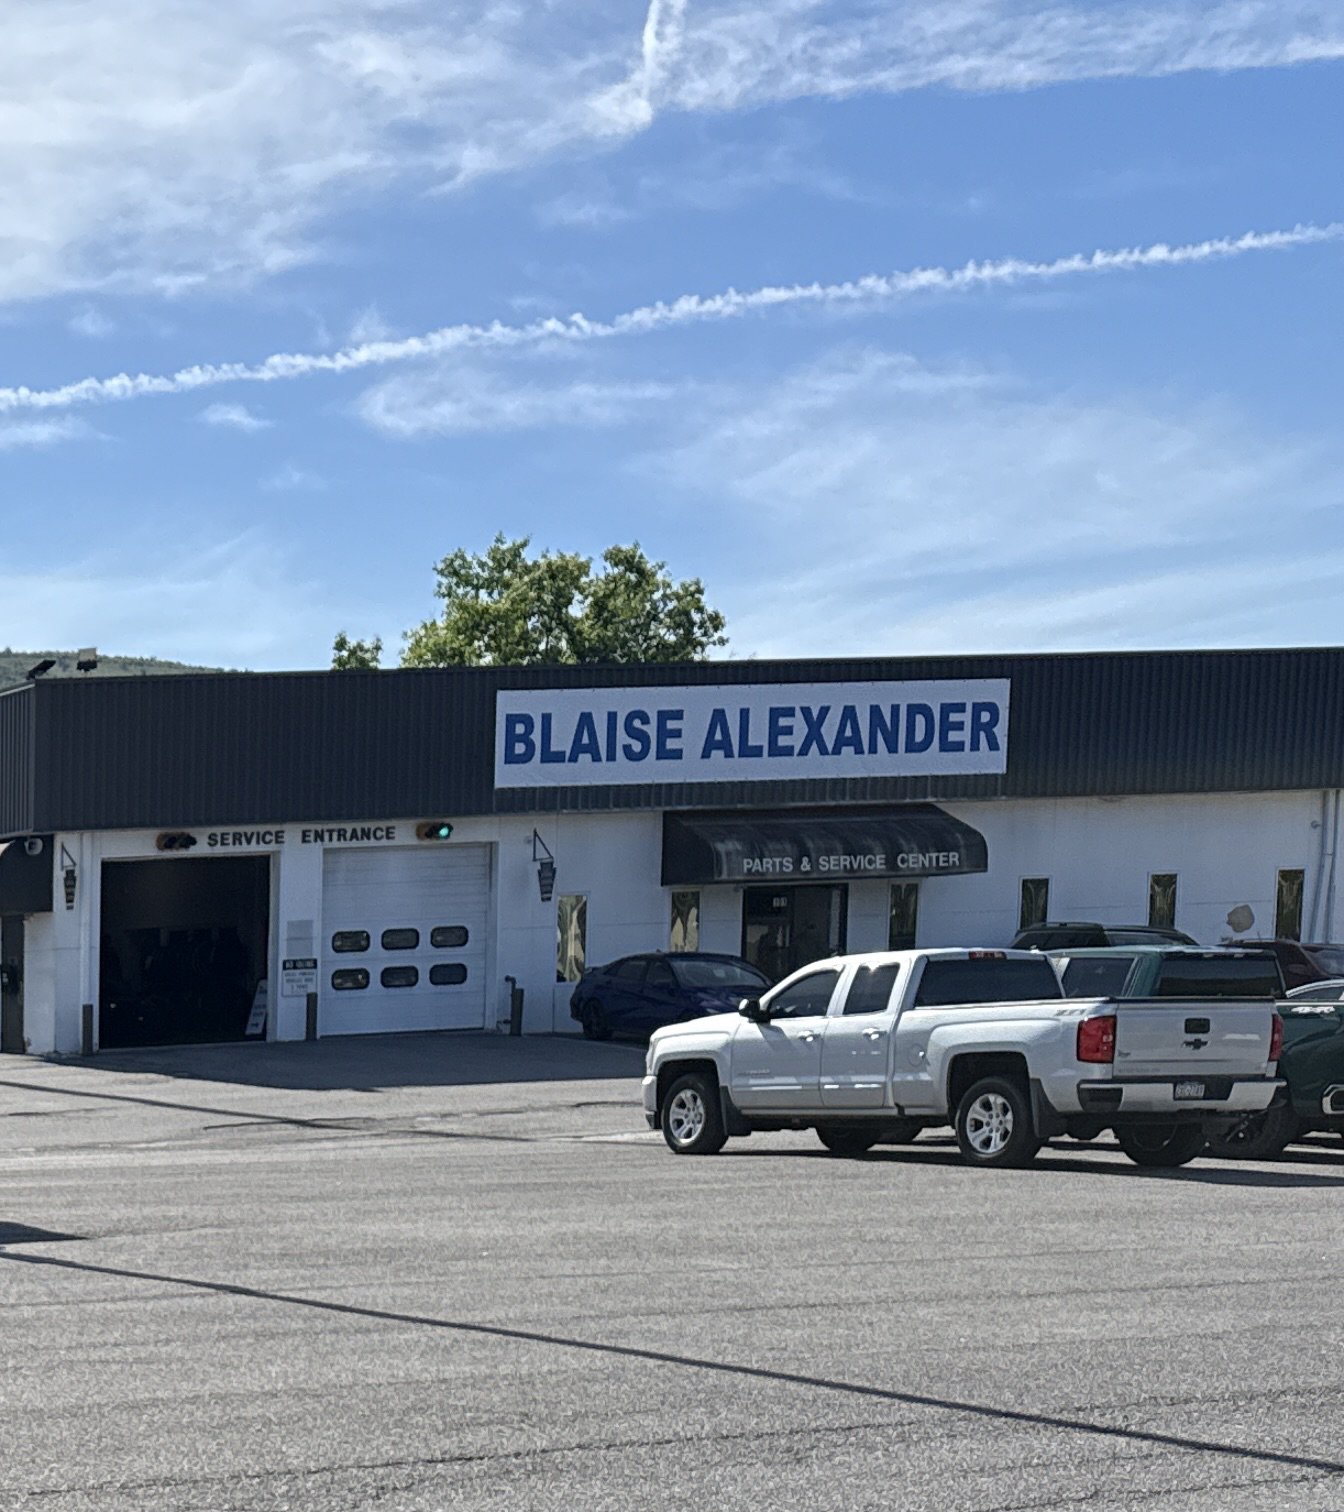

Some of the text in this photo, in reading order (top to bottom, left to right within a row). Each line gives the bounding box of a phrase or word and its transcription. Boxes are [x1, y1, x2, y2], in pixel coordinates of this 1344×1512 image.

[503, 702, 1001, 765] BLAISE ALEXANDER
[207, 826, 396, 847] SERVICE ENTRANCE
[743, 852, 960, 873] PARTS & SERVICE CENTER
